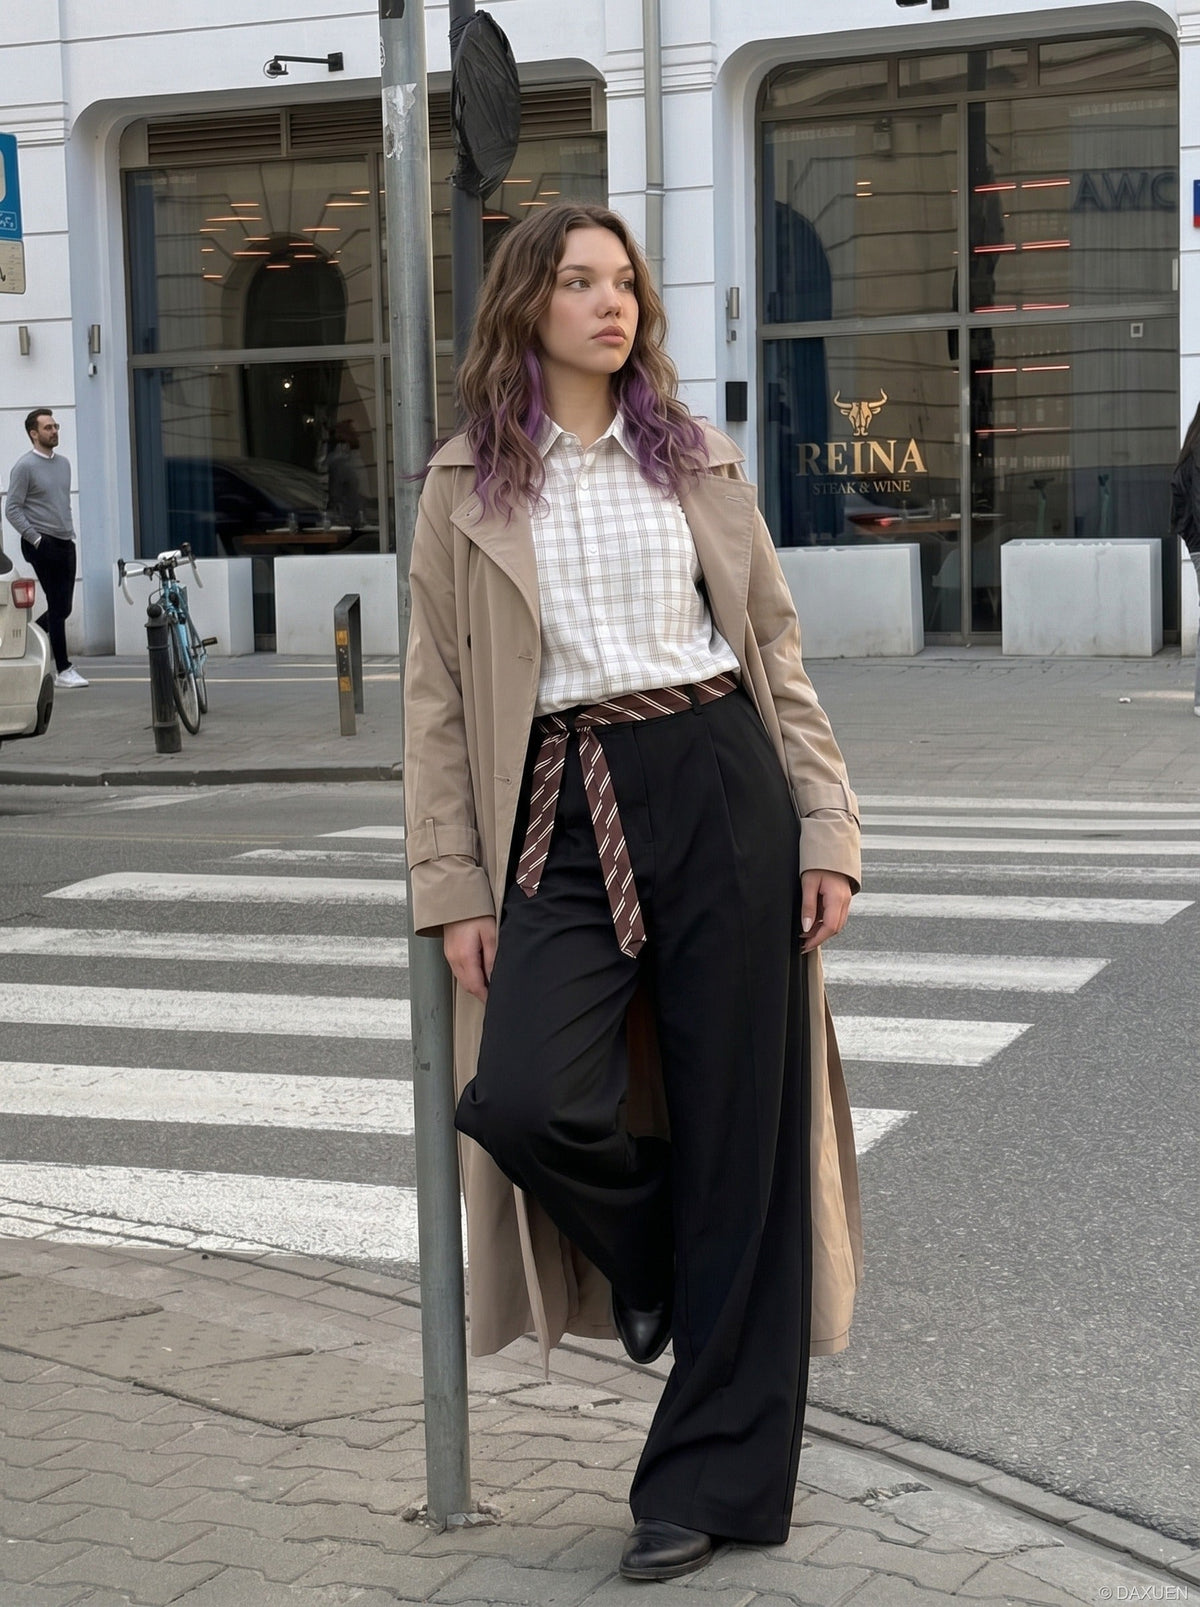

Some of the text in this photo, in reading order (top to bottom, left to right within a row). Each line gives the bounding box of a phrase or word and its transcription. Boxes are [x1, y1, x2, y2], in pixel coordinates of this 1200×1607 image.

[796, 438, 928, 476] REINA
[812, 480, 912, 495] STEAK & WINE
